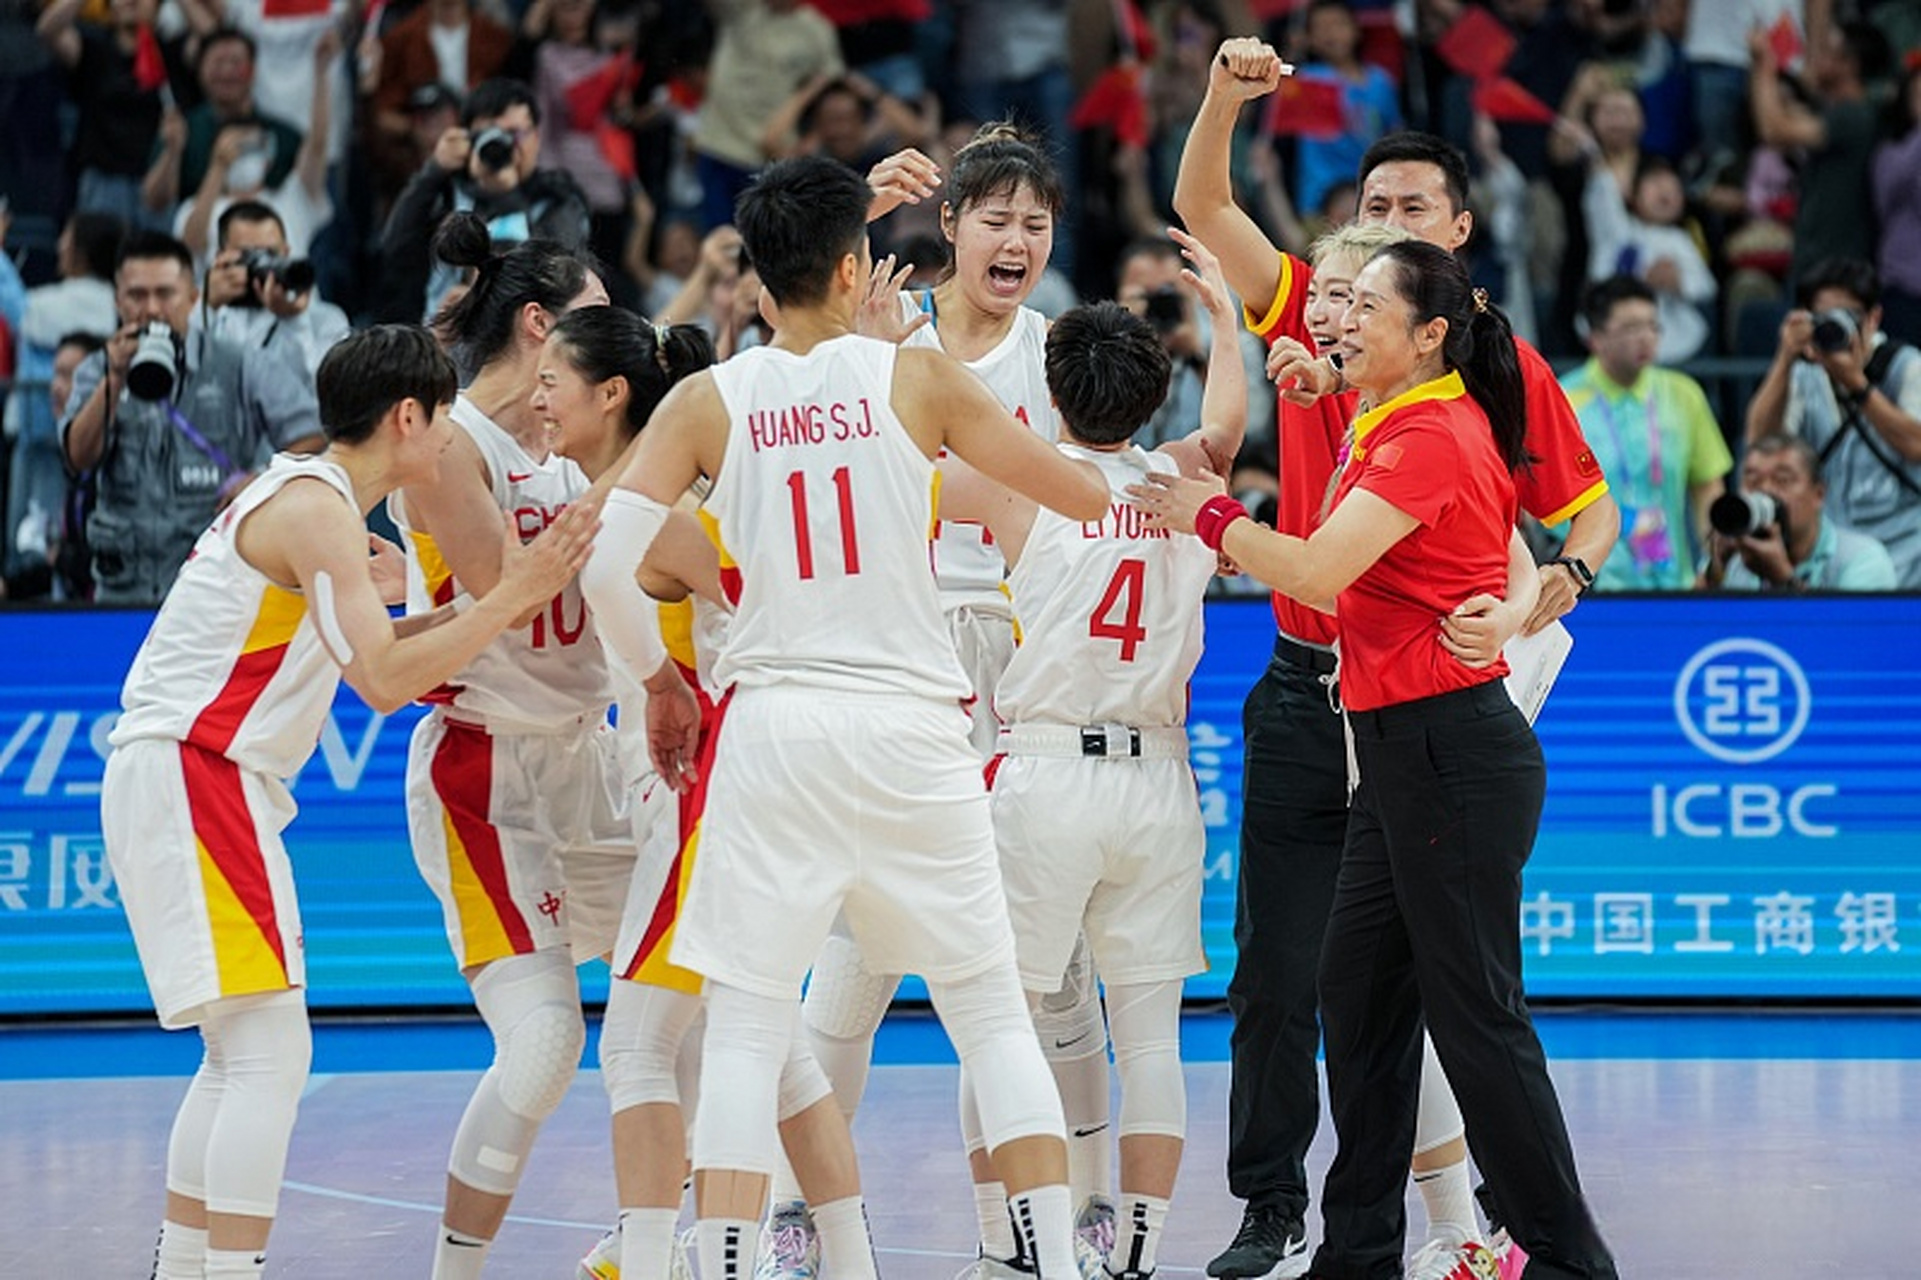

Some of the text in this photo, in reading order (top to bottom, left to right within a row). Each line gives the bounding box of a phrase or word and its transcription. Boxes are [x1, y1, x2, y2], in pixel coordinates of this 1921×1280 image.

[748, 398, 880, 452] HUANG S.J.
[786, 465, 861, 580] 11
[1089, 558, 1147, 663] 4
[1651, 783, 1839, 838] ICBC
[1520, 890, 1921, 957] 中国工商银
